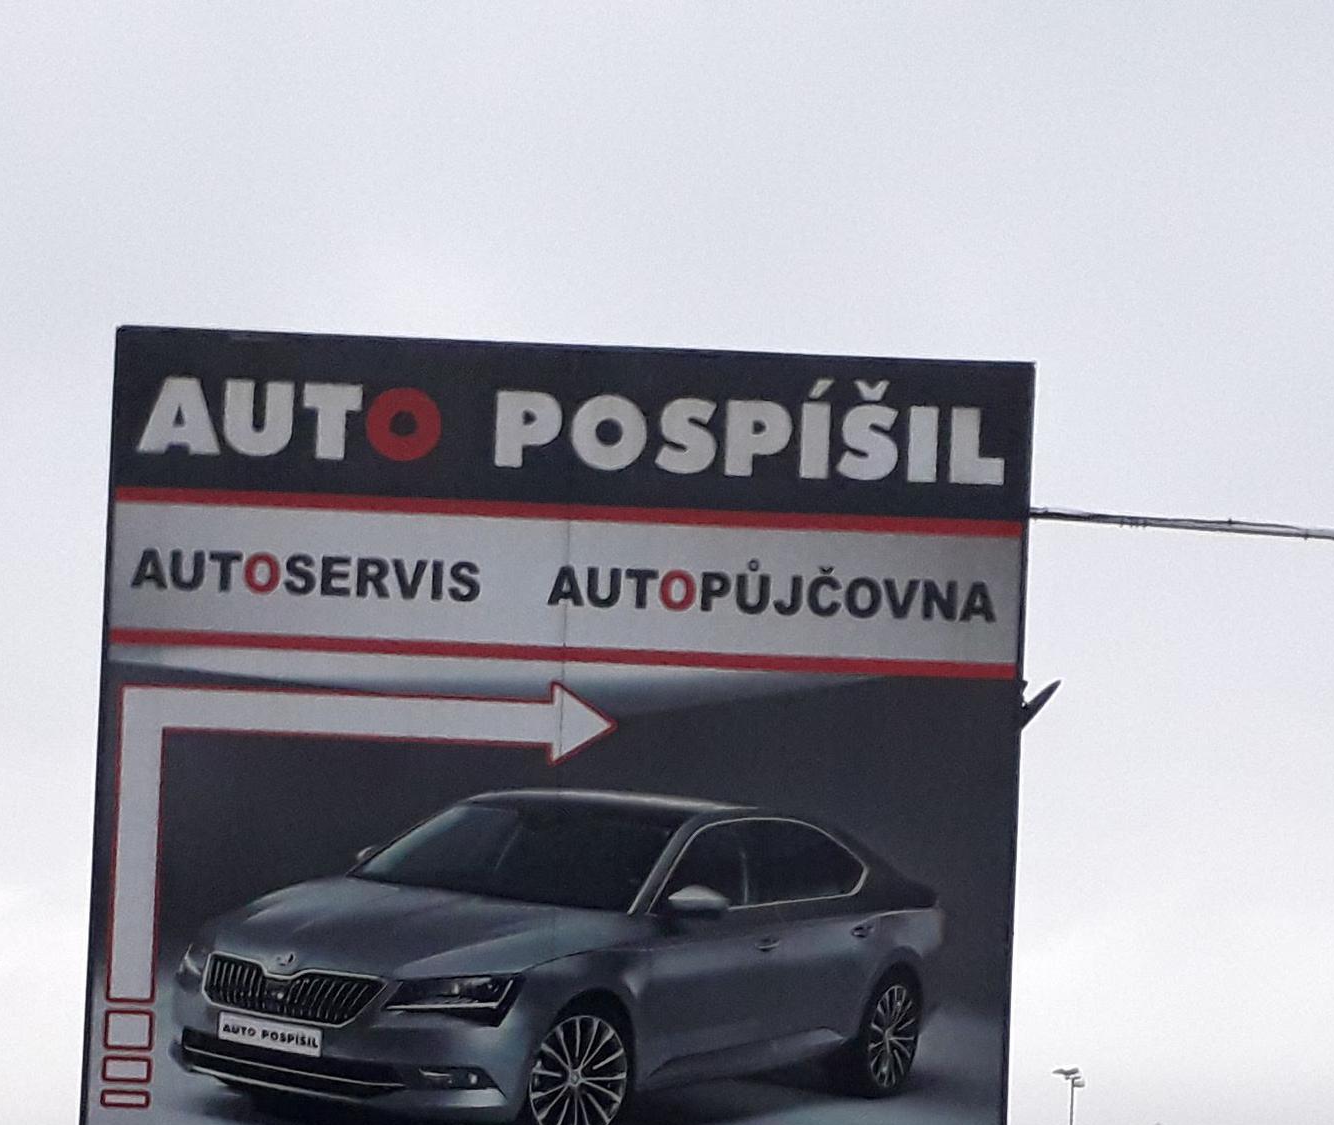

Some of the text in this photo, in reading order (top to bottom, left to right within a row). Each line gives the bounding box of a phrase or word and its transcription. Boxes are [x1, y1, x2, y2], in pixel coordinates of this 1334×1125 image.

[136, 375, 1006, 486] AUTO POSPÍŠIL
[130, 547, 482, 603] AUTOSERVIS
[546, 557, 997, 623] AUTOPŮJČOVNA
[223, 1024, 257, 1037] AUTO
